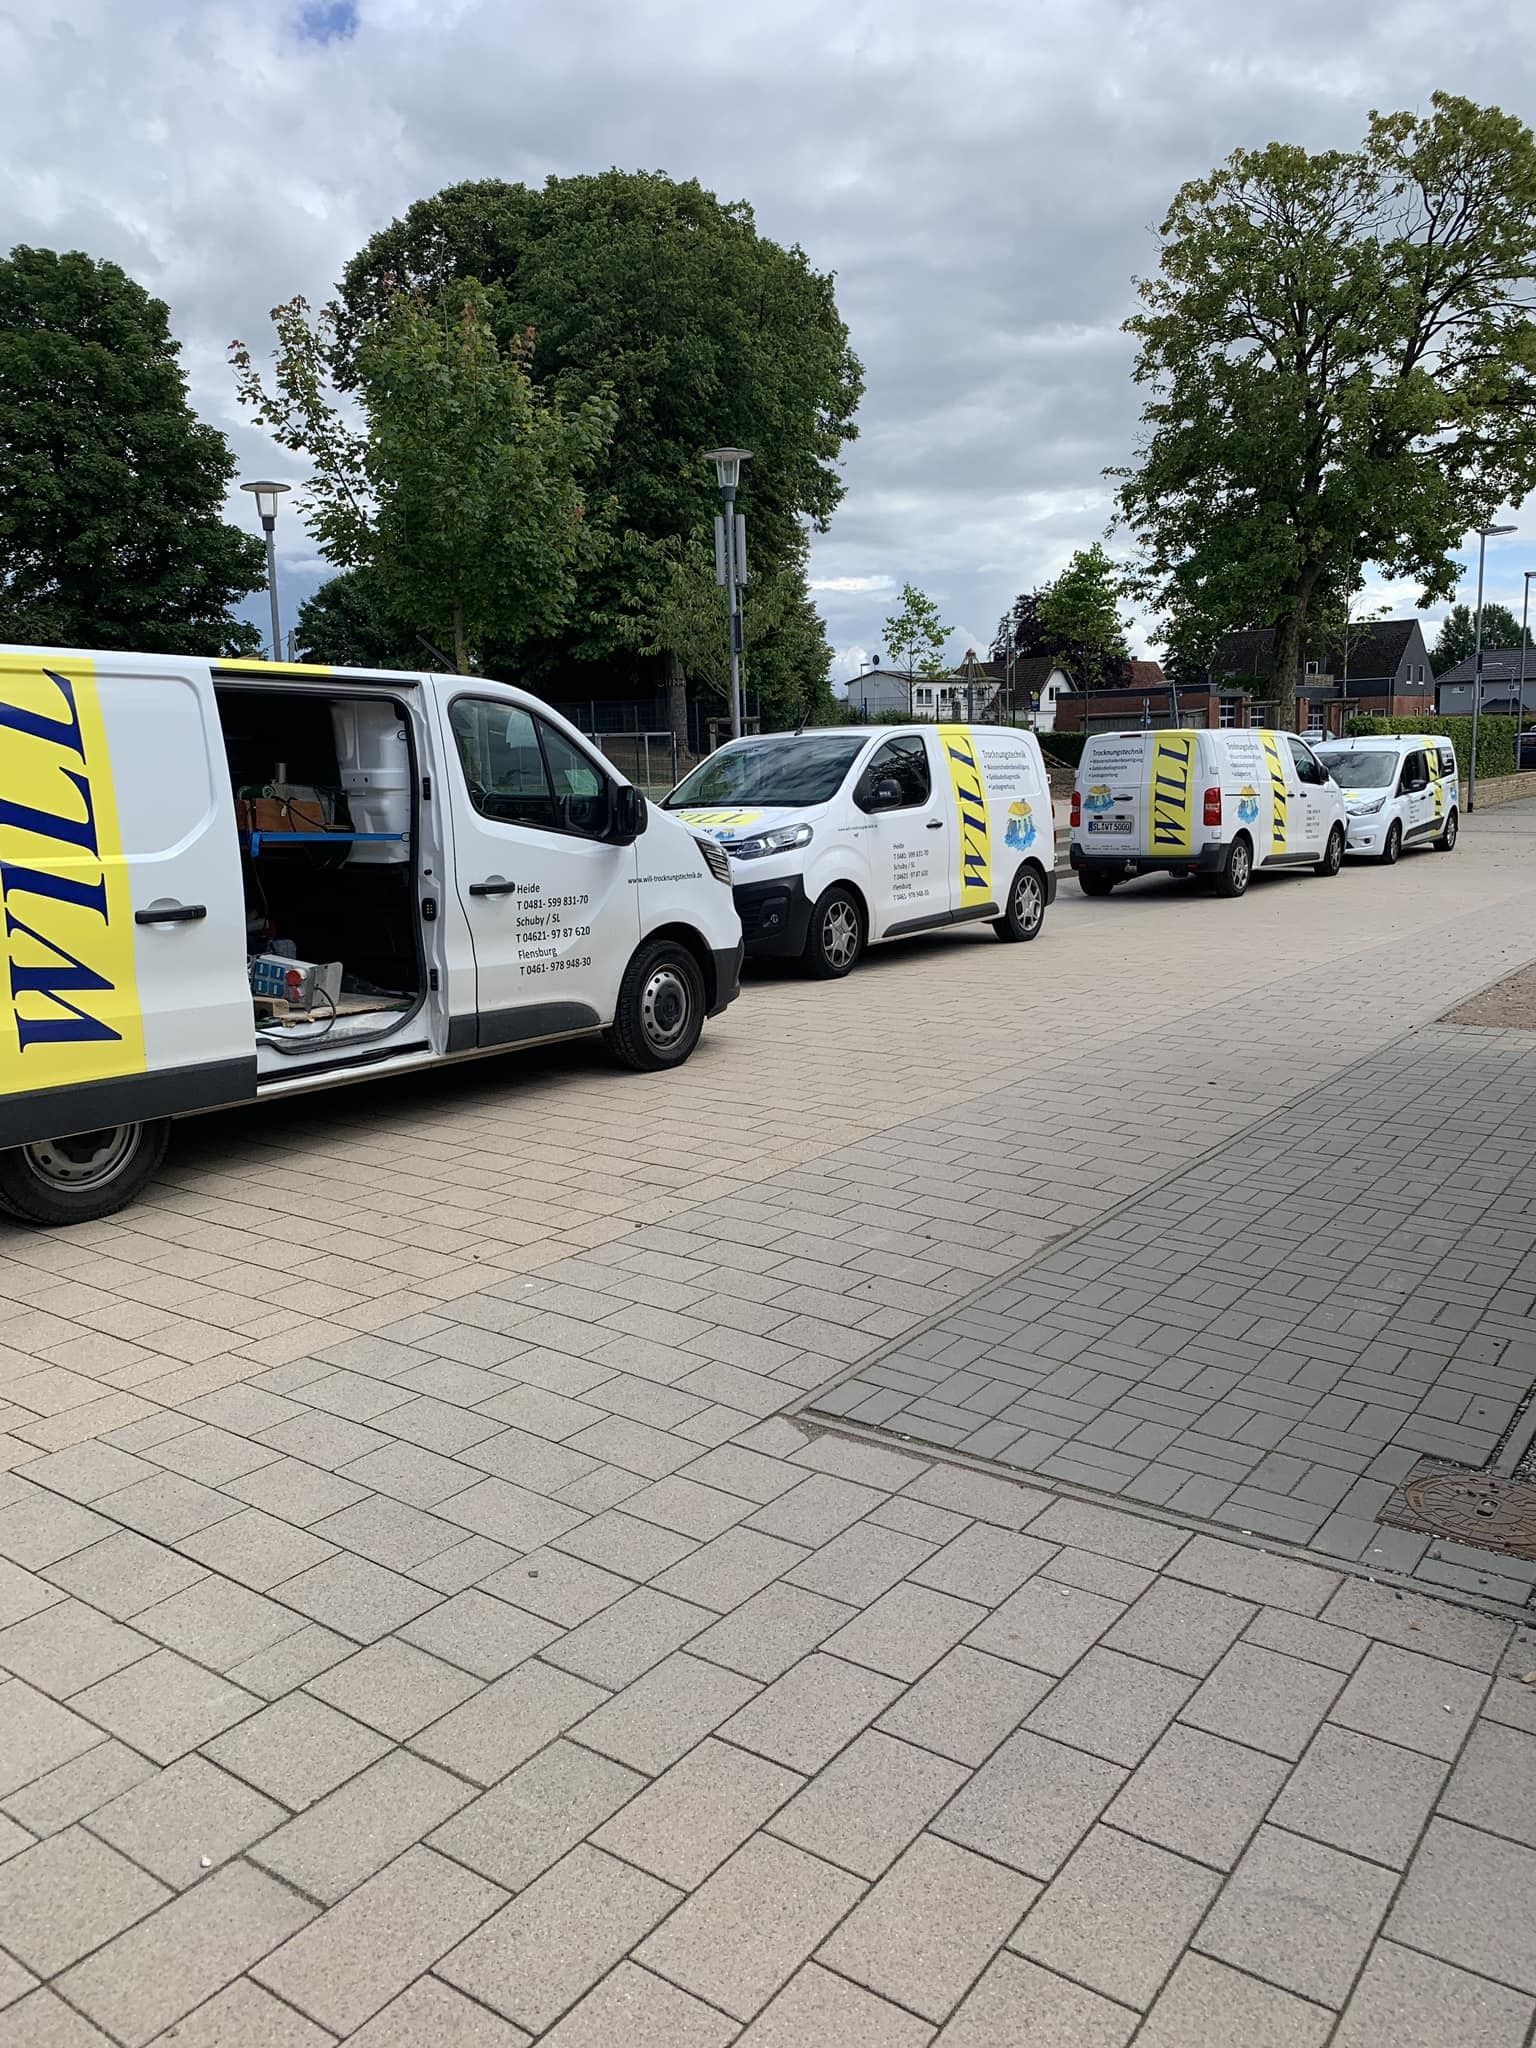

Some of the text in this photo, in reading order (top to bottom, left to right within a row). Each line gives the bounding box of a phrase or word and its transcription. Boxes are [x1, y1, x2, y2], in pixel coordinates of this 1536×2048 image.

[1092, 748, 1143, 757] Trocknungstechnik
[1153, 738, 1191, 846] WILL
[1263, 738, 1286, 842] WILL
[945, 736, 989, 888] WILL
[0, 668, 123, 1053] WILL
[516, 882, 541, 894] Heide
[516, 894, 589, 911] T 0481- 599 831-70
[516, 912, 561, 927] Schuby / SL
[515, 925, 591, 944] T 04621- 97 87 620
[517, 947, 559, 960] Flensburg
[519, 956, 592, 977] T 0461- 978 948-30
